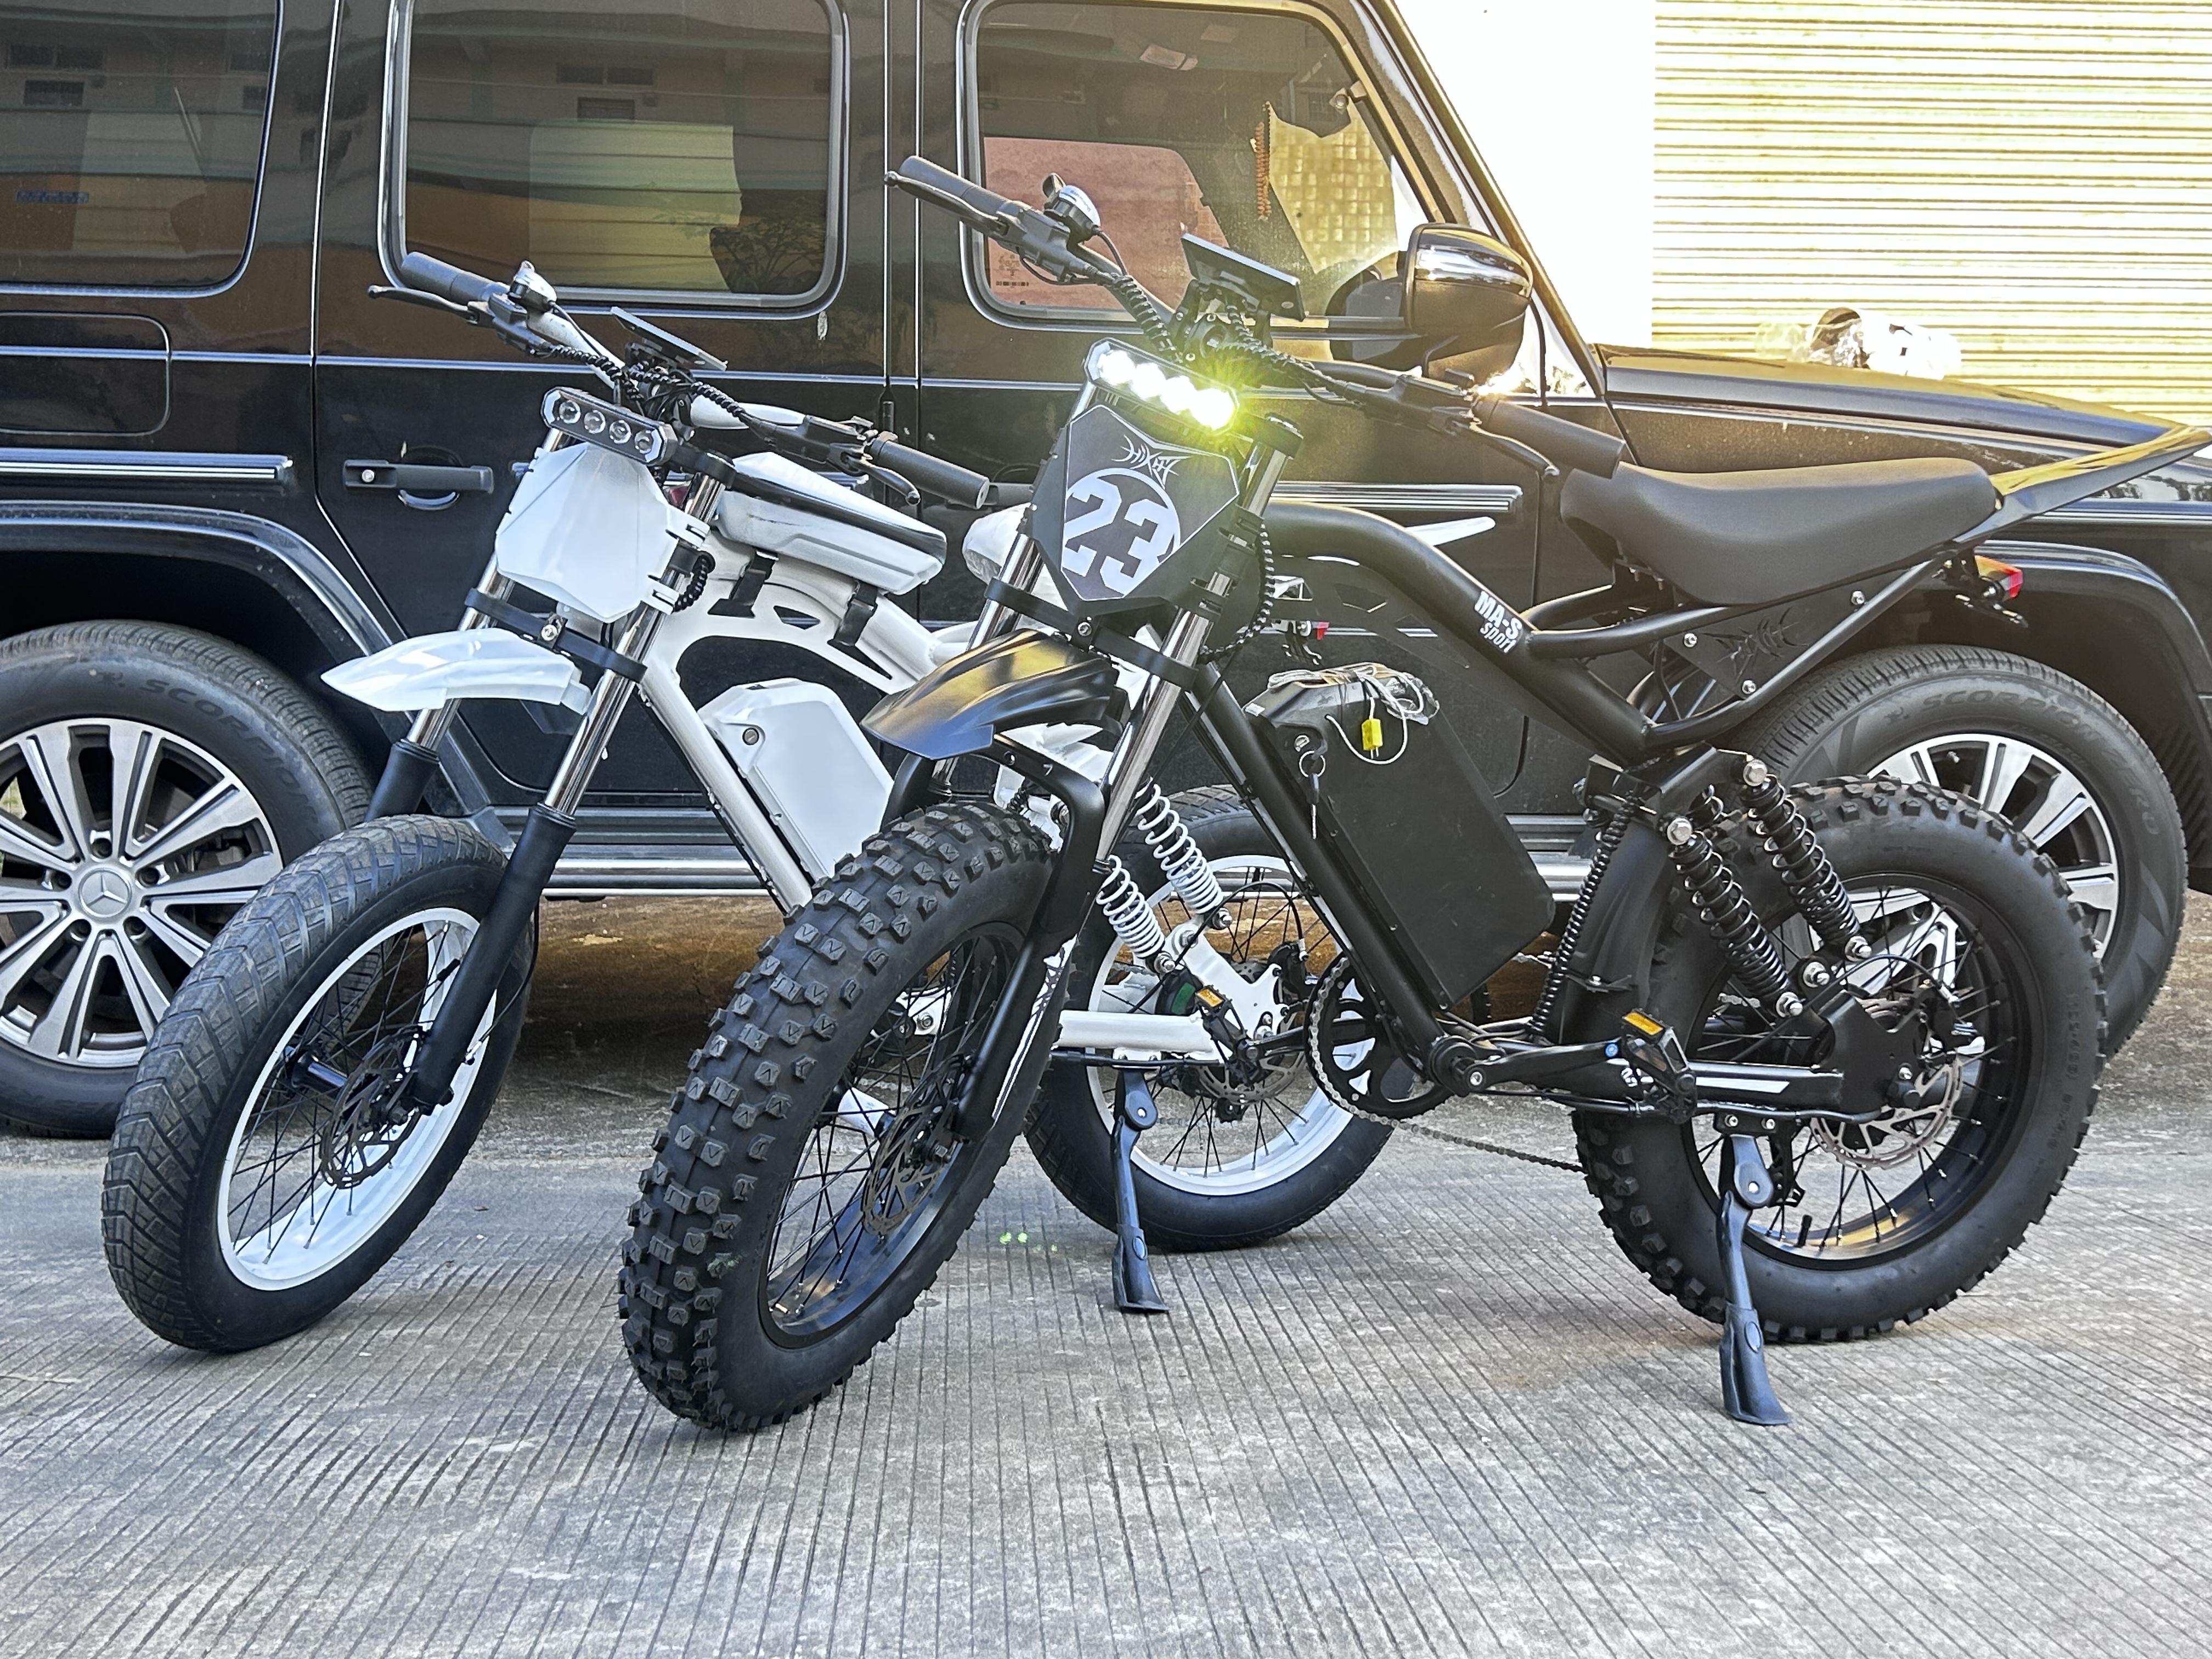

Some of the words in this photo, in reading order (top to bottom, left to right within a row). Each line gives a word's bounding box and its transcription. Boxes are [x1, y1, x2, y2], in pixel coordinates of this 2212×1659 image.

[1062, 476, 1175, 595] 23
[1474, 591, 1523, 640] MA-S
[1480, 622, 1516, 653] sport
[1922, 689, 2103, 742] SCORPION
